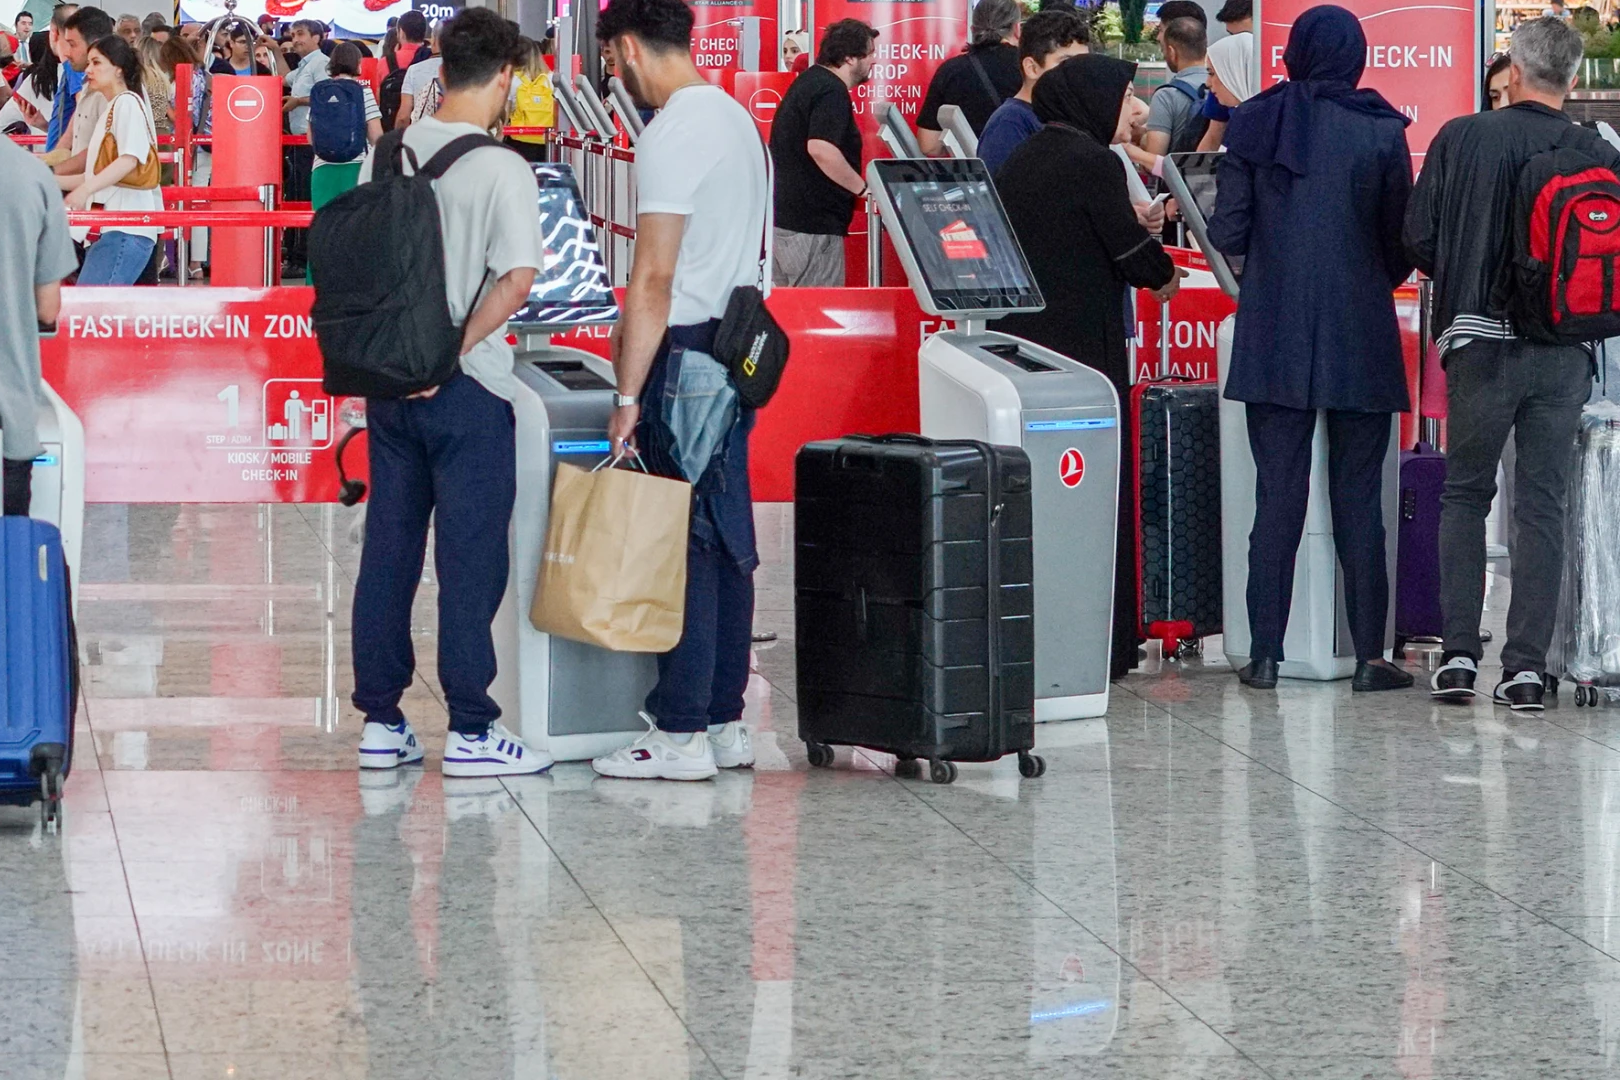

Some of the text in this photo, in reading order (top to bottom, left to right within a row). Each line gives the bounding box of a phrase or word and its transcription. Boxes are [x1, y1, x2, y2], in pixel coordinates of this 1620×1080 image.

[420, 4, 454, 17] 20m
[699, 38, 739, 51] CHEC
[874, 44, 945, 60] HECK-IN
[1366, 45, 1452, 68] ECK-IN
[696, 54, 732, 67] DROP
[857, 85, 921, 98] CHECK-IN
[69, 315, 317, 339] FAST CHECK-IN ZON
[217, 384, 239, 427] 1
[206, 435, 226, 444] STEP
[228, 452, 260, 464] KIOSK
[271, 452, 311, 464] MOBILE
[242, 469, 298, 481] CHECK-IN
